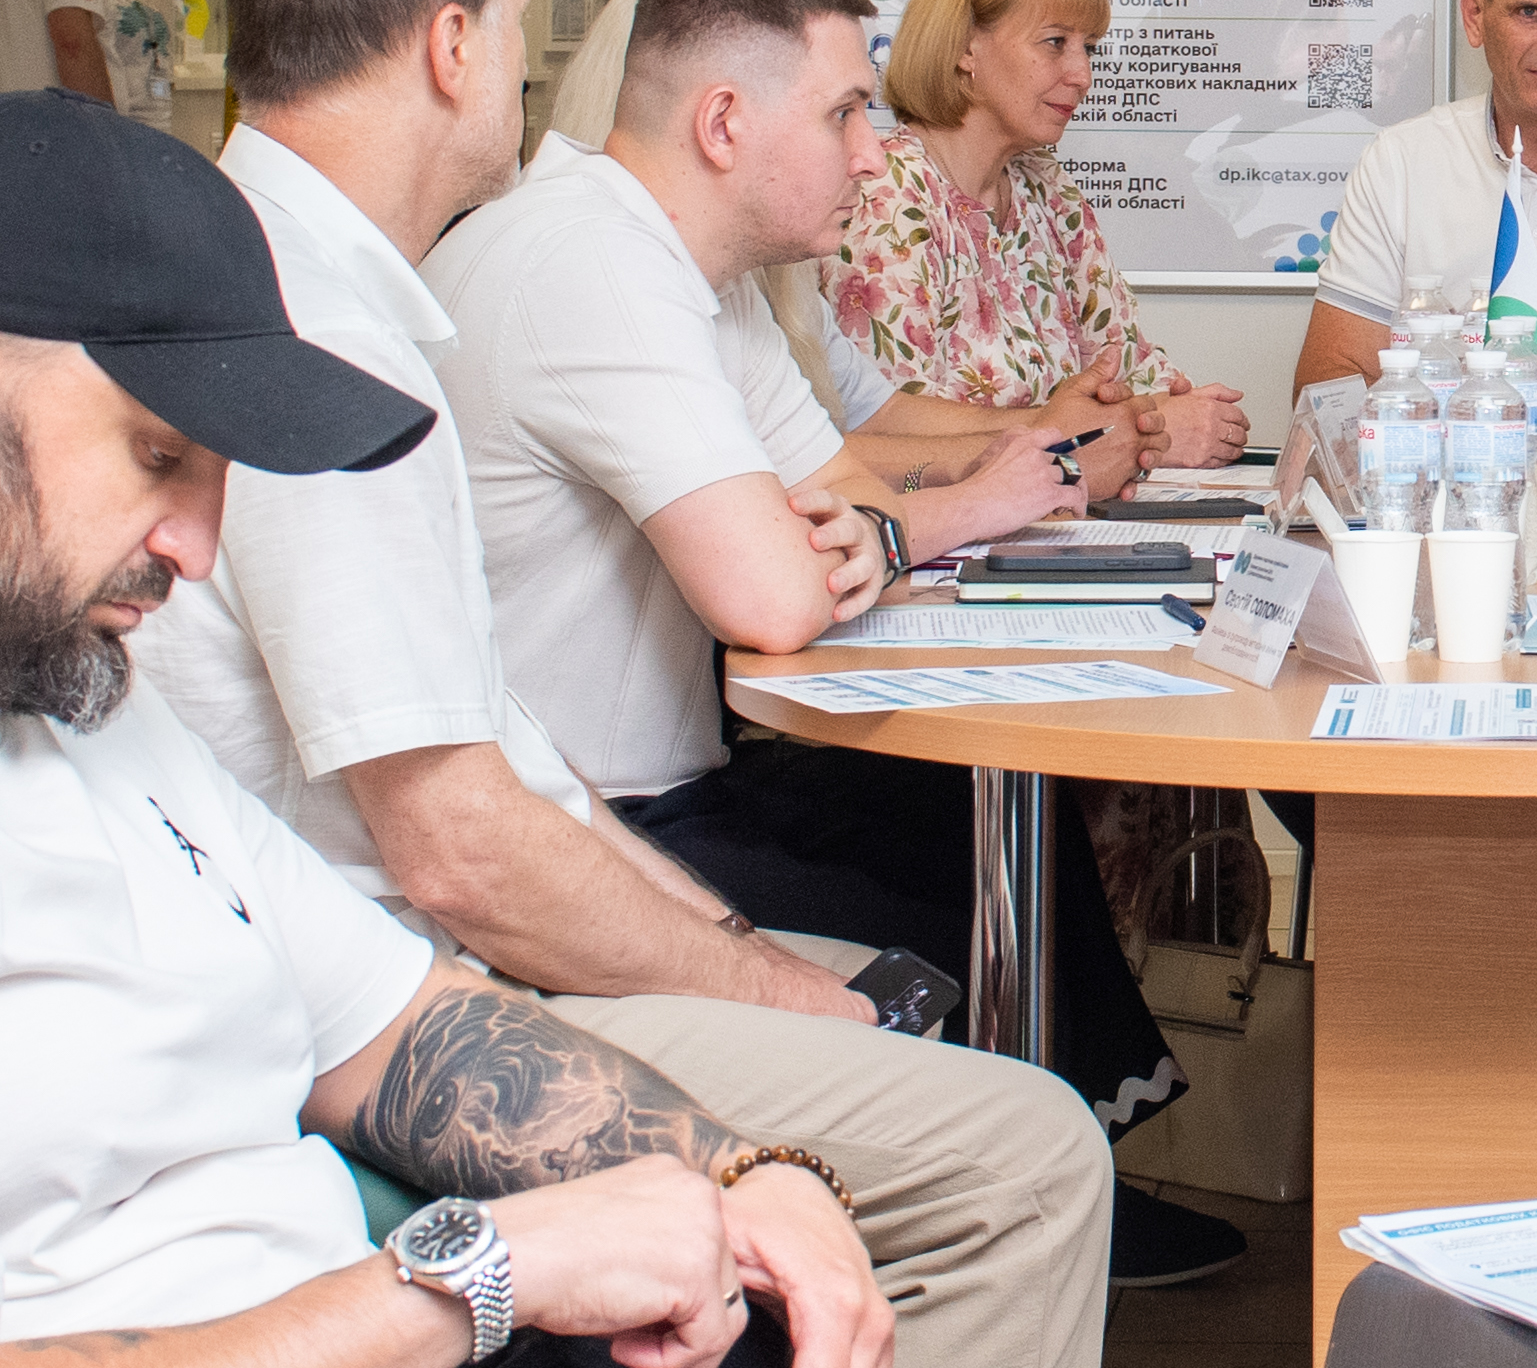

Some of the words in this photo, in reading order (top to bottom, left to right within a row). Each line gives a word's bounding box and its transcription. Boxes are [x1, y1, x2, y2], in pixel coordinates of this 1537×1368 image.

[1104, 28, 1134, 42] нтр
[1139, 28, 1148, 39] з
[1153, 28, 1215, 40] питань
[1119, 42, 1219, 58] податкової
[1128, 61, 1242, 75] коригування
[1093, 76, 1196, 90] податкових
[1202, 78, 1298, 92] накладних
[1122, 93, 1161, 108] ДПС
[1112, 109, 1178, 123] області
[1219, 168, 1350, 184] dp.ikc@tax.gov
[1128, 177, 1168, 193] ДПС
[1117, 195, 1185, 210] області
[1249, 597, 1297, 628] СОЛОМАХА
